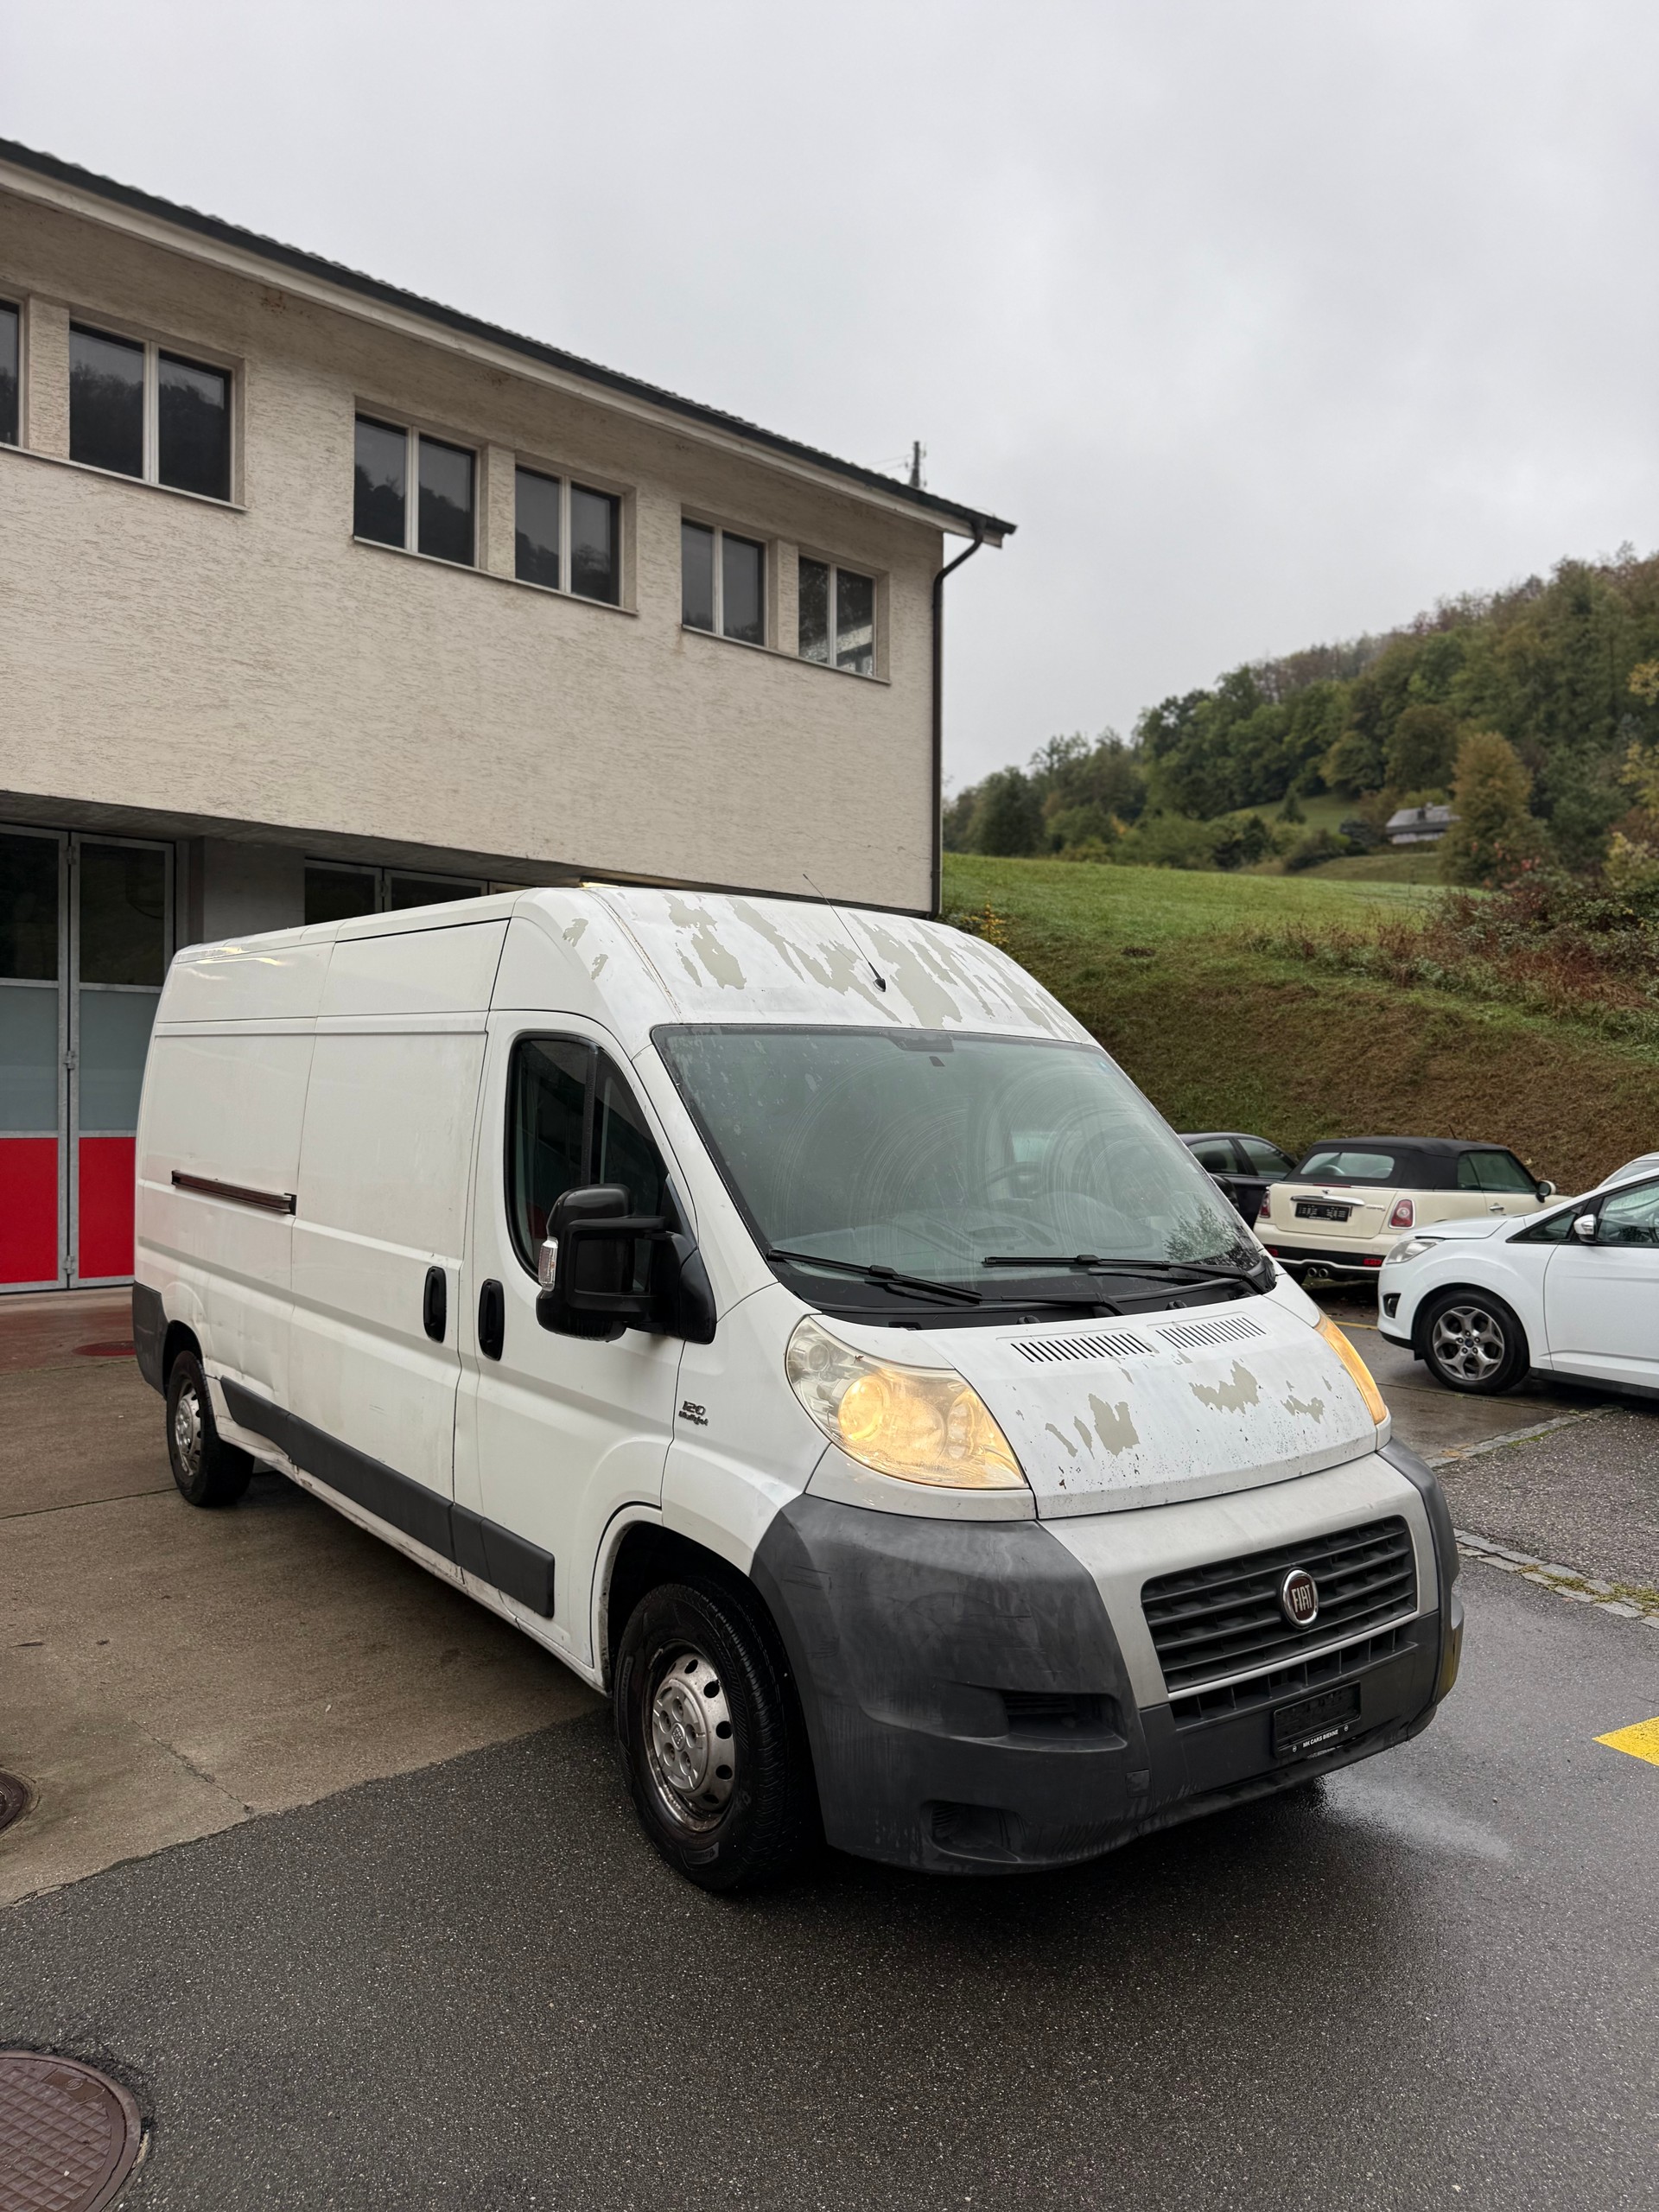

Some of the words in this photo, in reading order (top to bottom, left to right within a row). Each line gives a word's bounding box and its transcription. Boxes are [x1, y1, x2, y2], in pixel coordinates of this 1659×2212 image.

[682, 1401, 706, 1416] 120
[1291, 1585, 1313, 1612] FIAT
[1302, 1739, 1311, 1748] MK
[1310, 1735, 1323, 1745] CARS
